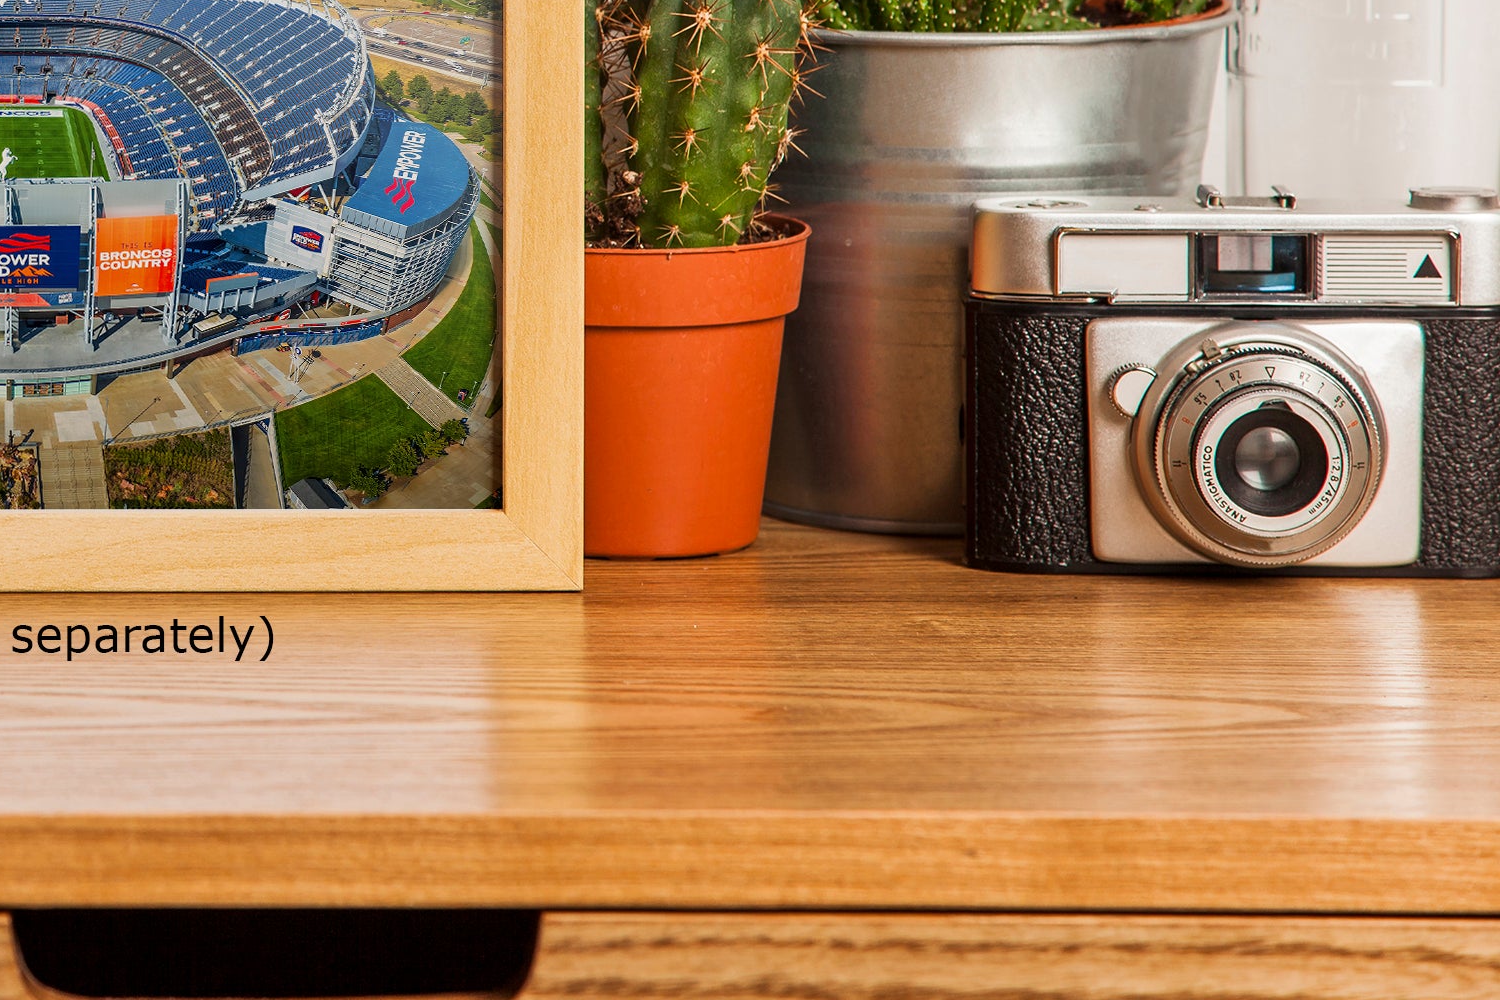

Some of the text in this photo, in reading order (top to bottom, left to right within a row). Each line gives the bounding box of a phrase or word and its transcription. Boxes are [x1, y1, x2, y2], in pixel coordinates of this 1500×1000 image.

[393, 130, 427, 181] EMPOWER
[99, 248, 173, 261] BRONCOS
[100, 258, 172, 270] COUNTRY
[1203, 445, 1247, 523] ANASTIGMATICO
